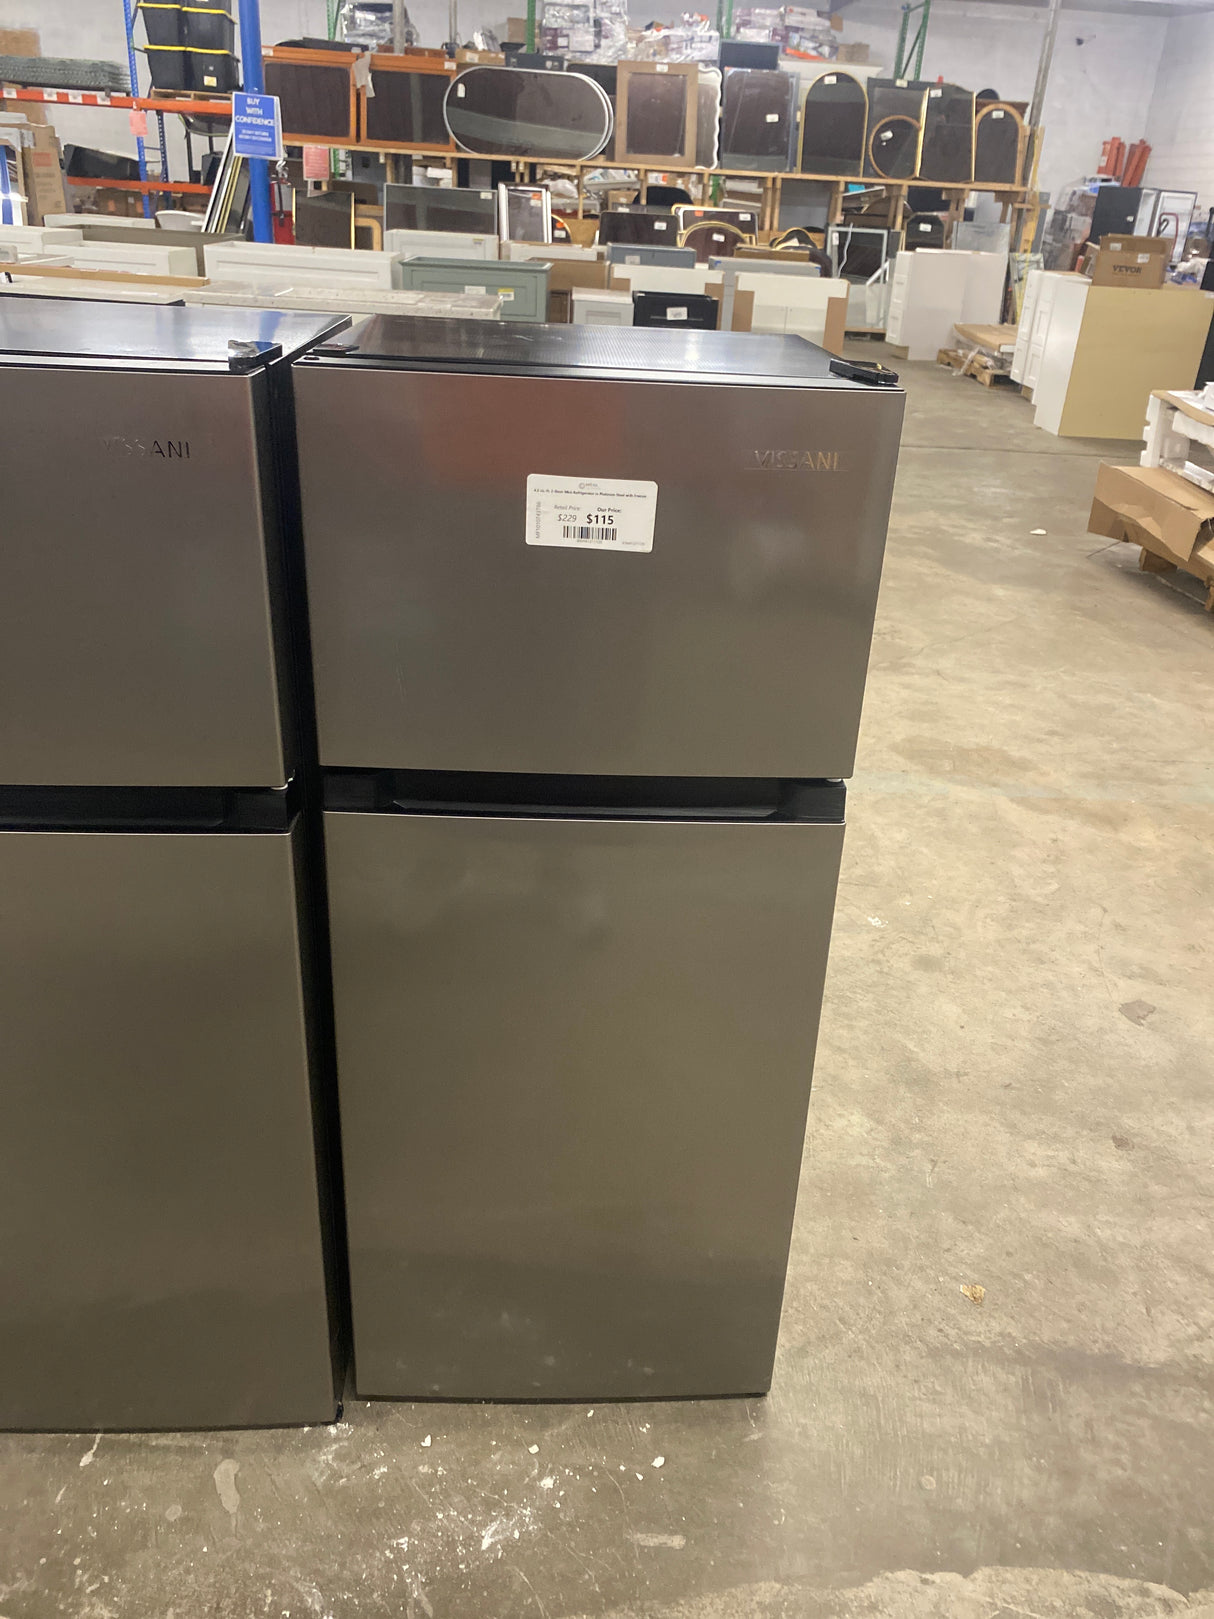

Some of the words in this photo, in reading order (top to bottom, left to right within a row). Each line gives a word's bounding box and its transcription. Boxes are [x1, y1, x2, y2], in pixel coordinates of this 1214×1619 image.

[246, 107, 262, 115] WITH
[235, 116, 275, 126] CONFIDENCE
[558, 513, 577, 522] $229
[587, 513, 613, 525] $115
